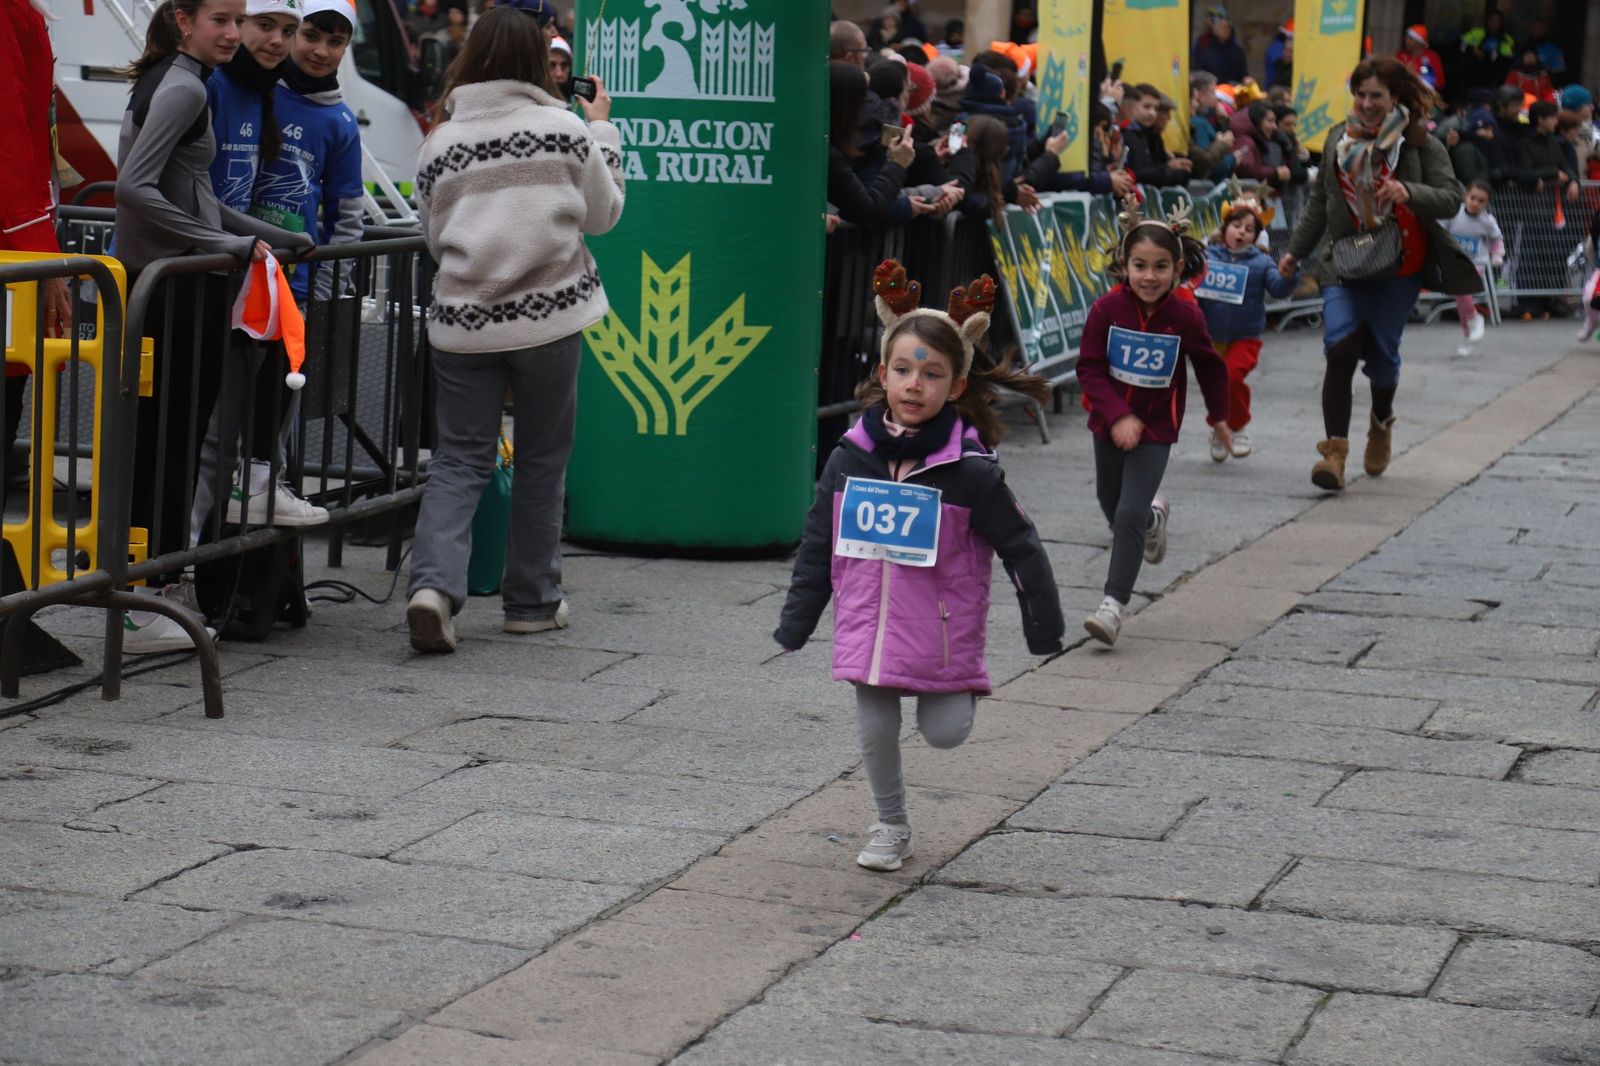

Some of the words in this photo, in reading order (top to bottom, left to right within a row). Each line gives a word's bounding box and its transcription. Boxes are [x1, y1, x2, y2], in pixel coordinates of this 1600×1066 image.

[239, 122, 253, 138] 46
[282, 123, 303, 140] 46
[610, 117, 774, 151] NDACION
[656, 152, 773, 184] RURAL
[1205, 270, 1237, 290] 092
[1121, 345, 1165, 370] 123
[856, 500, 920, 537] 037
